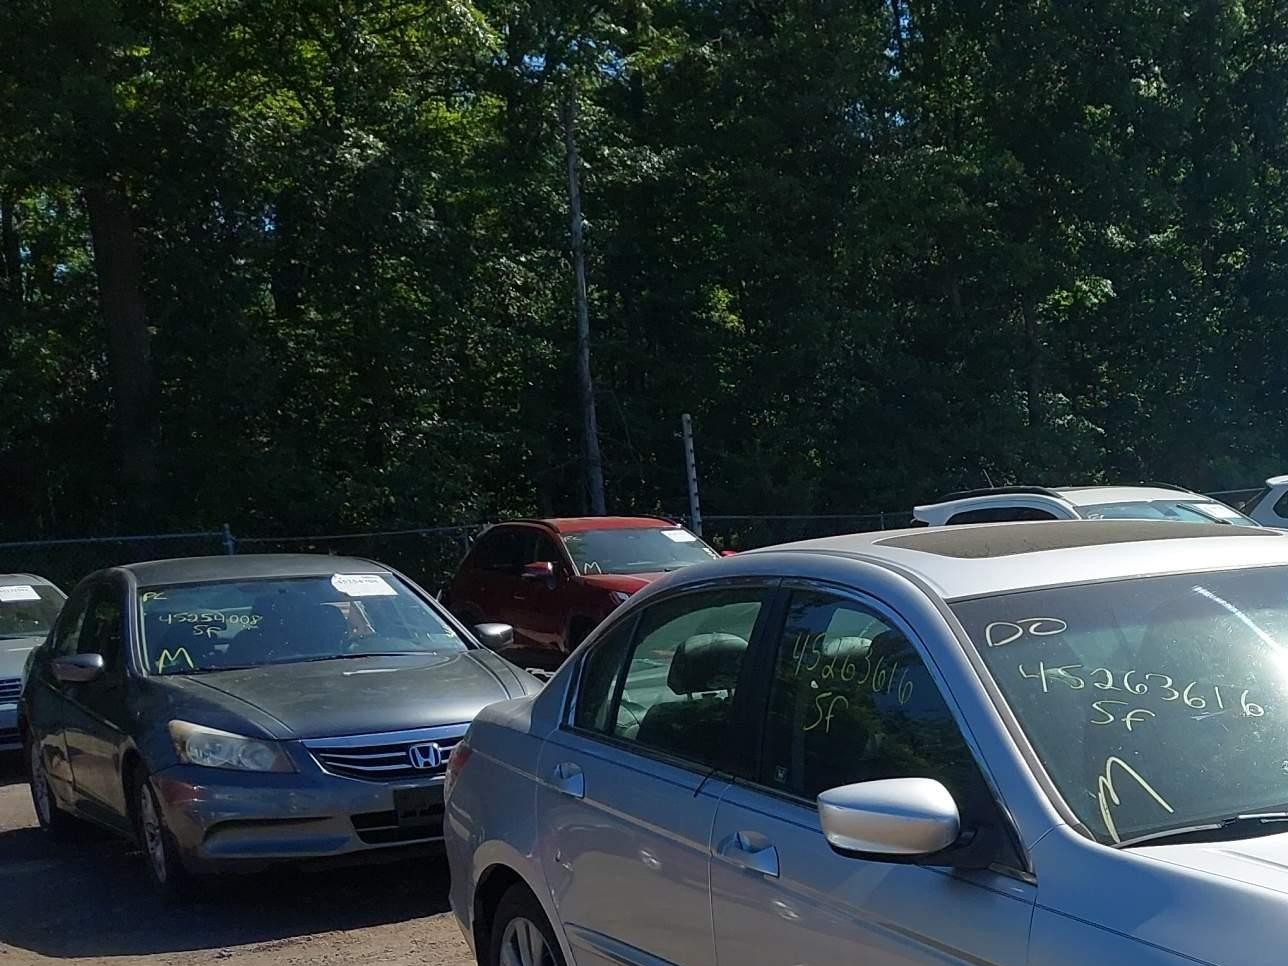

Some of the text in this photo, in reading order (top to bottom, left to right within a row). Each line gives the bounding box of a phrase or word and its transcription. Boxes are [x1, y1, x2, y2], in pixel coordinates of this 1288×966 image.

[158, 648, 195, 675] M
[793, 632, 913, 706] 45263616
[1019, 661, 1266, 717] 45263616
[1098, 756, 1176, 844] M
